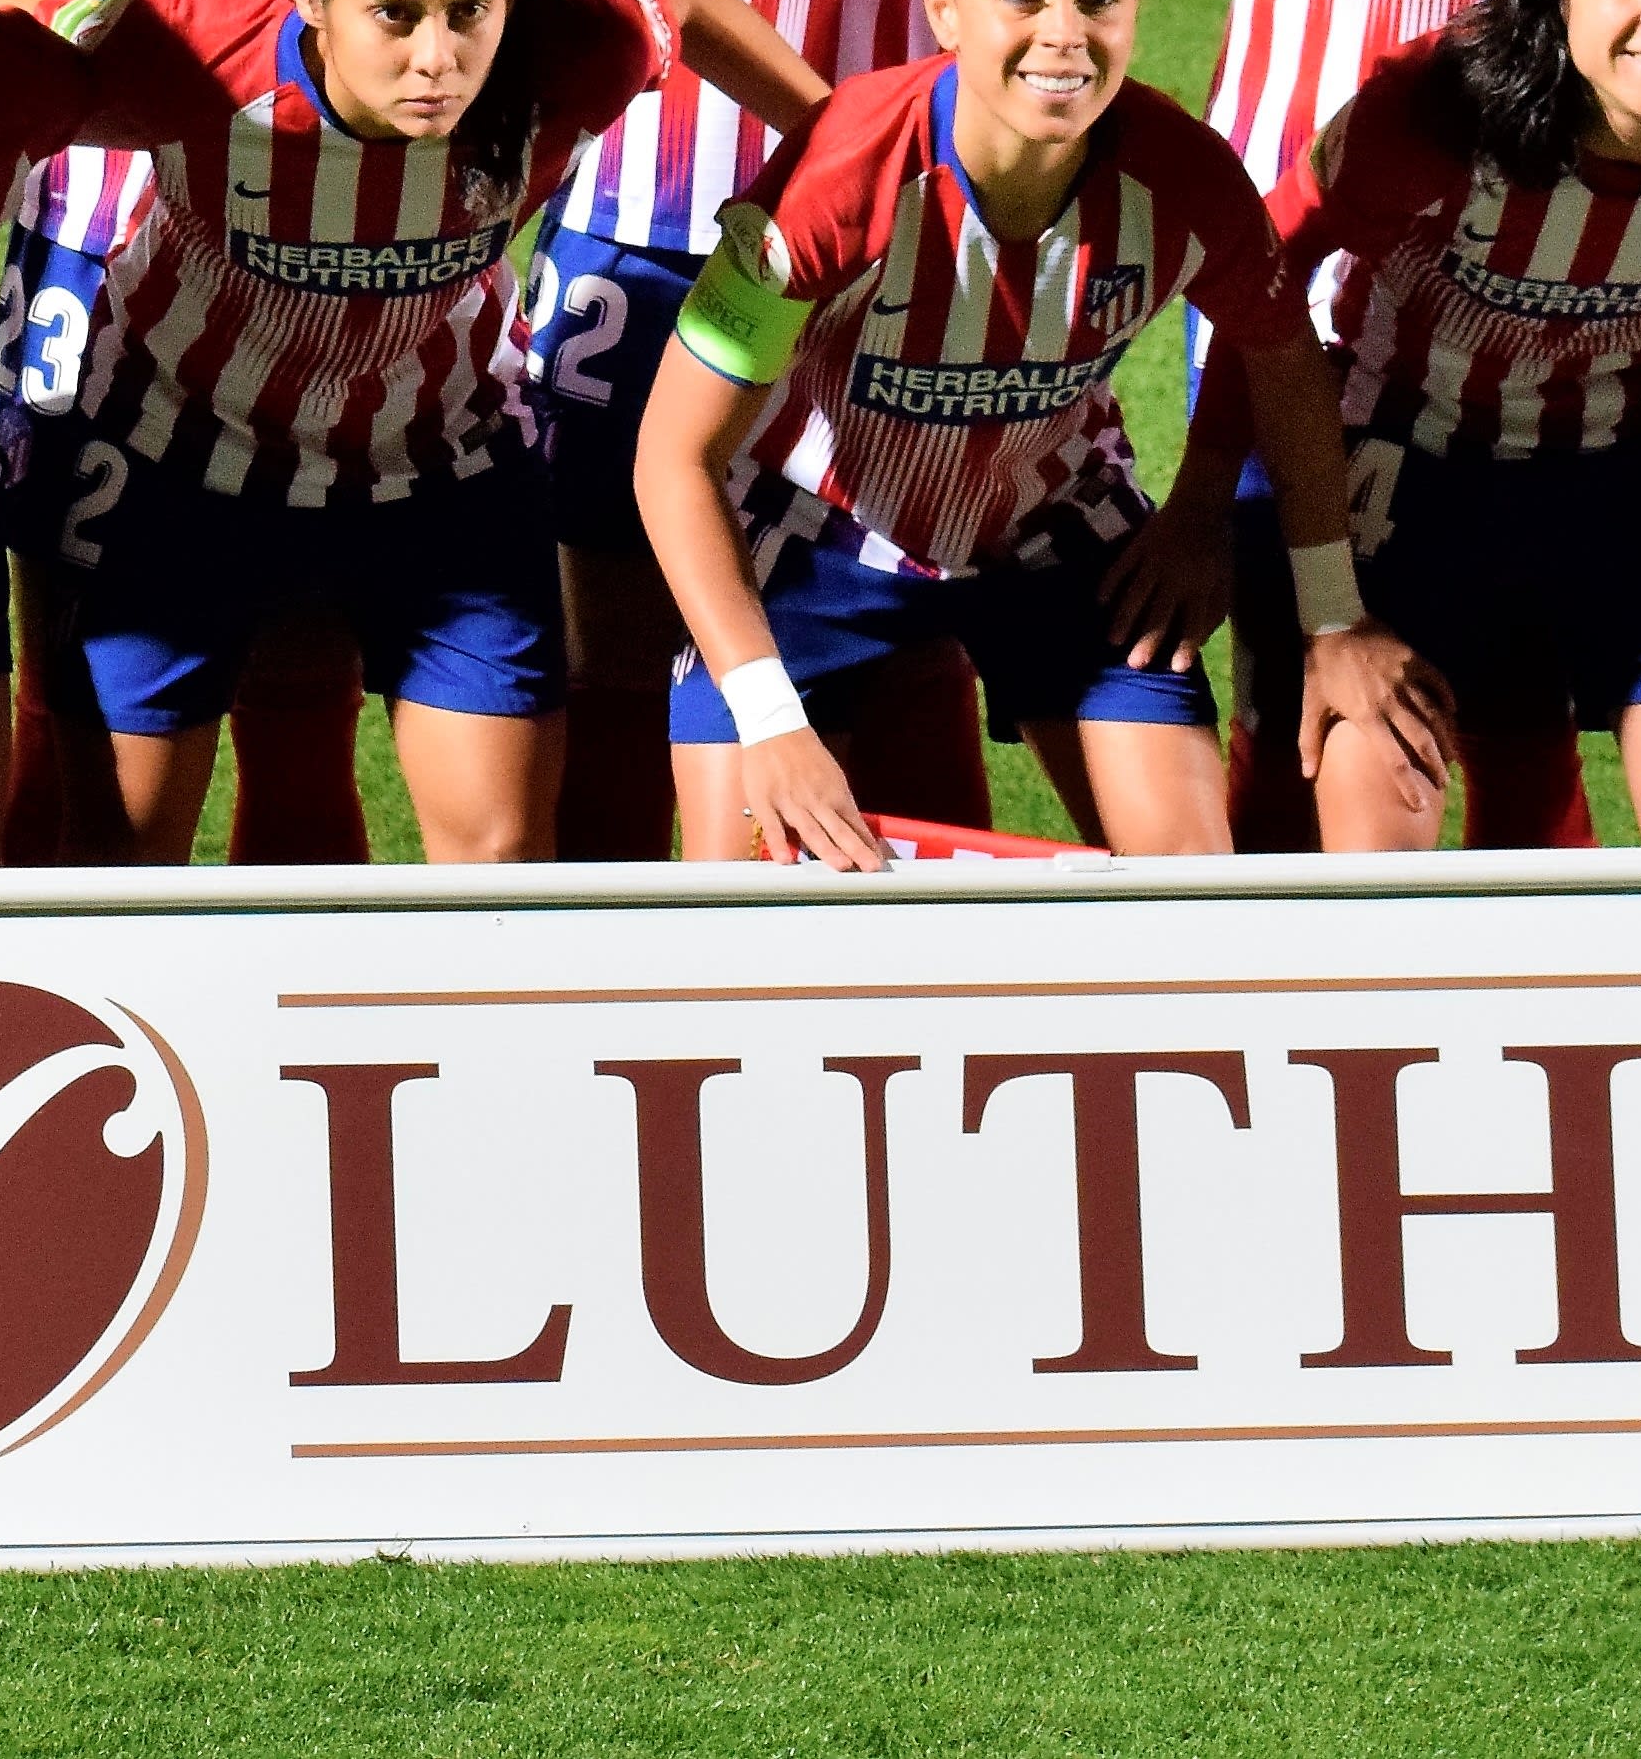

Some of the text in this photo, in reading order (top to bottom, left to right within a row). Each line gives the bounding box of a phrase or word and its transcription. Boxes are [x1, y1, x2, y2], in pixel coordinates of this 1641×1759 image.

[246, 229, 494, 268] HERBALIFE
[246, 247, 491, 290] NUTRITION
[867, 379, 1091, 417] NUTRITIO
